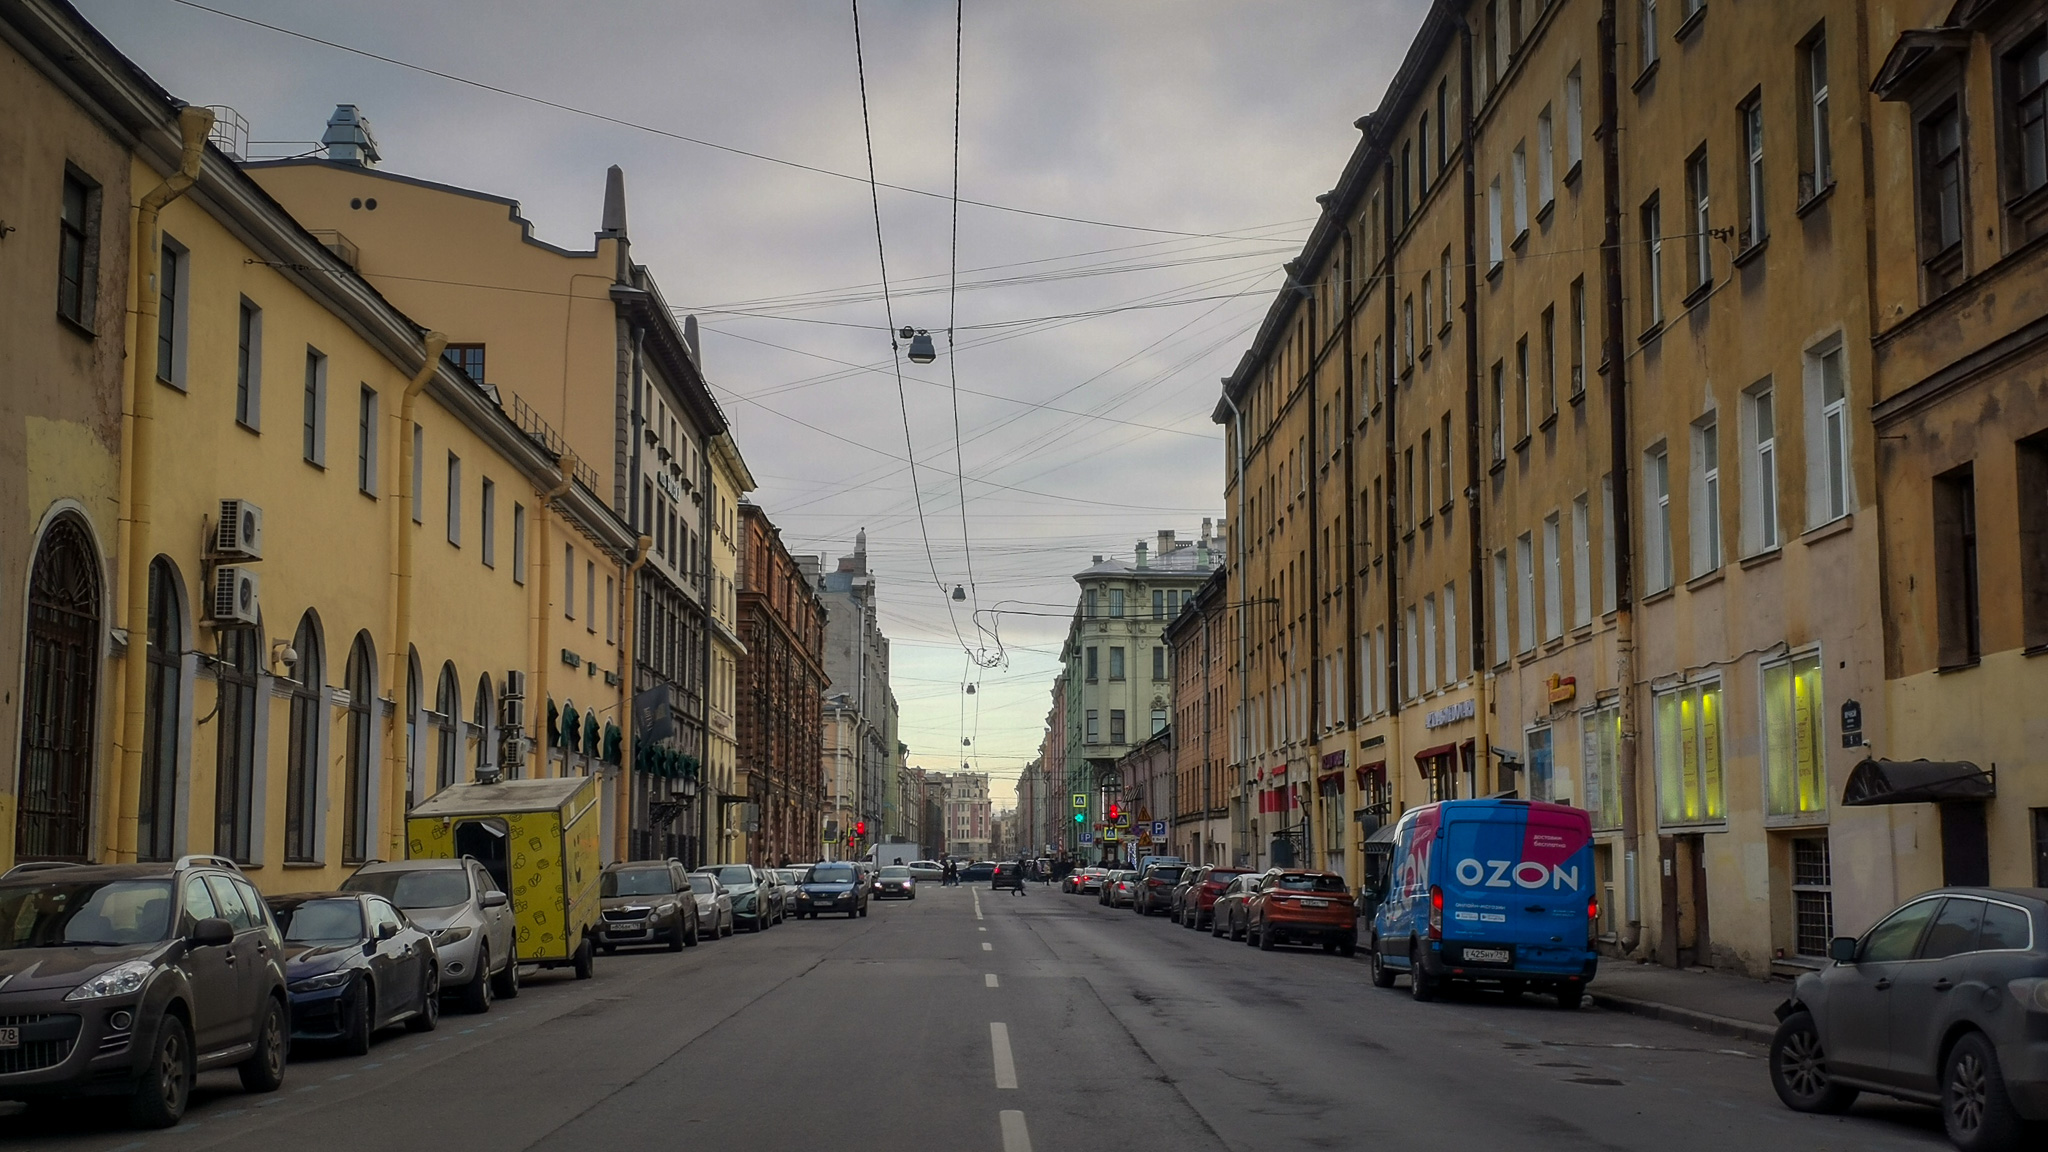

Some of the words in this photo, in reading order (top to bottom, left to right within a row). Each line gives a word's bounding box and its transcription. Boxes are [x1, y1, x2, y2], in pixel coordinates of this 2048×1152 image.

[1155, 822, 1164, 834] P
[1456, 858, 1579, 892] OZON
[1, 1029, 16, 1041] 78
